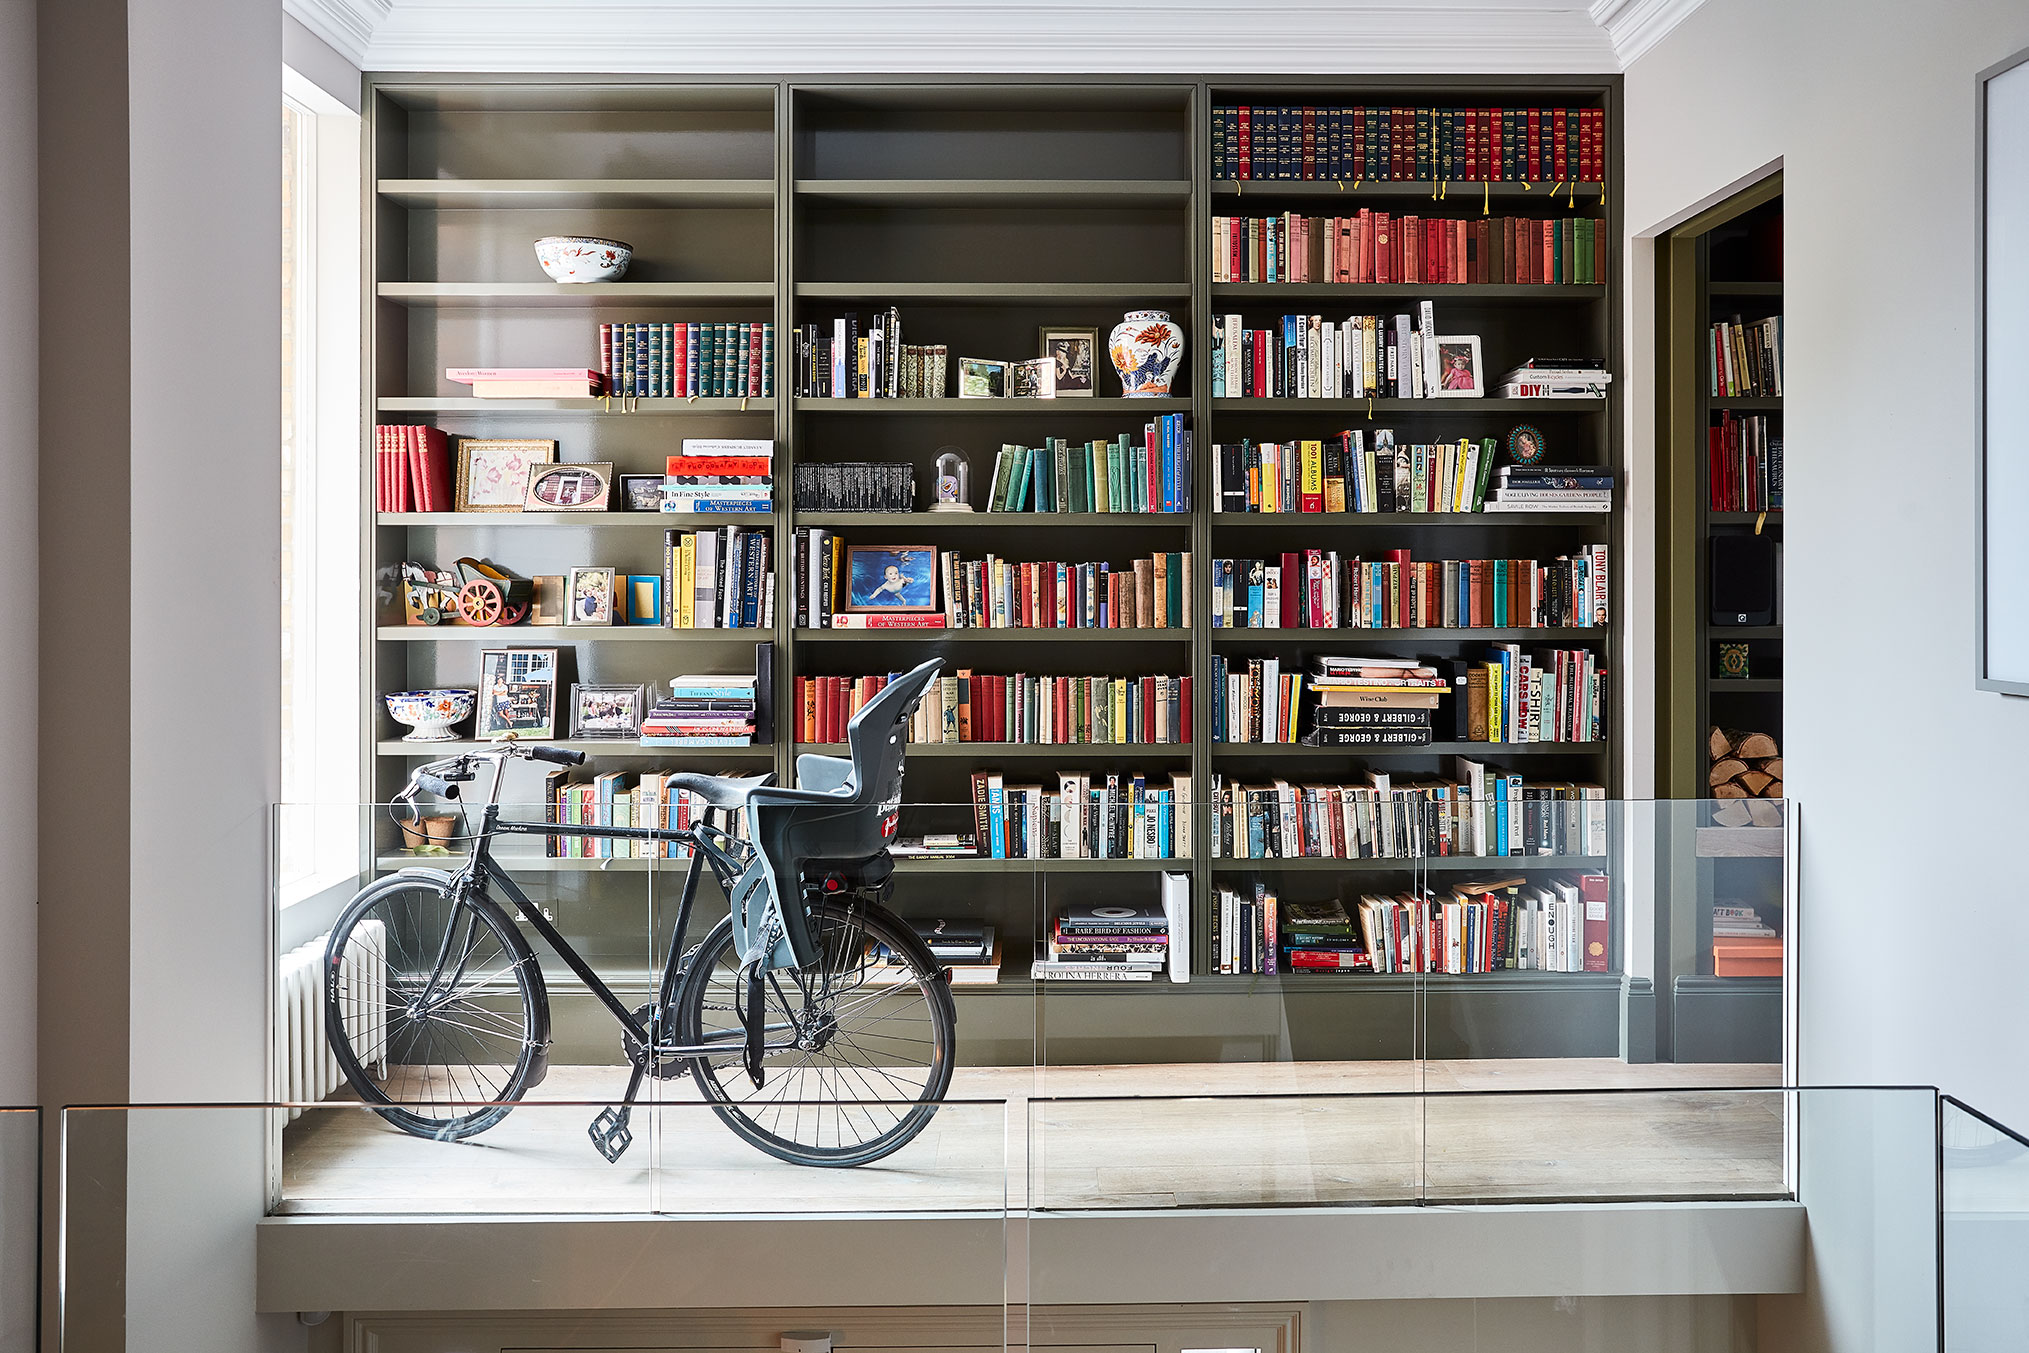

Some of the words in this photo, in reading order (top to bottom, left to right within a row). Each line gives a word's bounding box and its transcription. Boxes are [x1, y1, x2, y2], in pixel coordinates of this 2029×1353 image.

[1424, 308, 1432, 319] DAVID
[1425, 321, 1433, 339] HOCKNEY
[1402, 362, 1407, 370] OF
[1520, 385, 1542, 397] DIY
[694, 491, 711, 499] Style
[748, 538, 756, 578] WESTERN
[822, 551, 831, 567] New
[1595, 550, 1606, 572] TONY
[822, 567, 830, 580] York
[747, 580, 755, 598] ART
[1595, 574, 1607, 600] BLAIR
[1519, 665, 1530, 698] CARS
[713, 688, 732, 697] Style
[1530, 677, 1542, 729] T-SHIRT
[1338, 713, 1371, 722] GEORGE
[1374, 713, 1380, 722] &
[1381, 713, 1416, 723] GILBERT
[1519, 700, 1529, 729] NOW
[1338, 733, 1371, 743] GEORGE
[1375, 733, 1380, 742] &
[1382, 733, 1417, 743] GILBERT
[976, 779, 986, 803] ZADIE
[979, 805, 988, 831] SMITH
[1030, 805, 1040, 837] Sapiens
[1147, 814, 1156, 823] JO
[1725, 909, 1744, 917] BOOK
[1034, 972, 1082, 980] CROLINA
[1087, 972, 1128, 980] HERRERA
